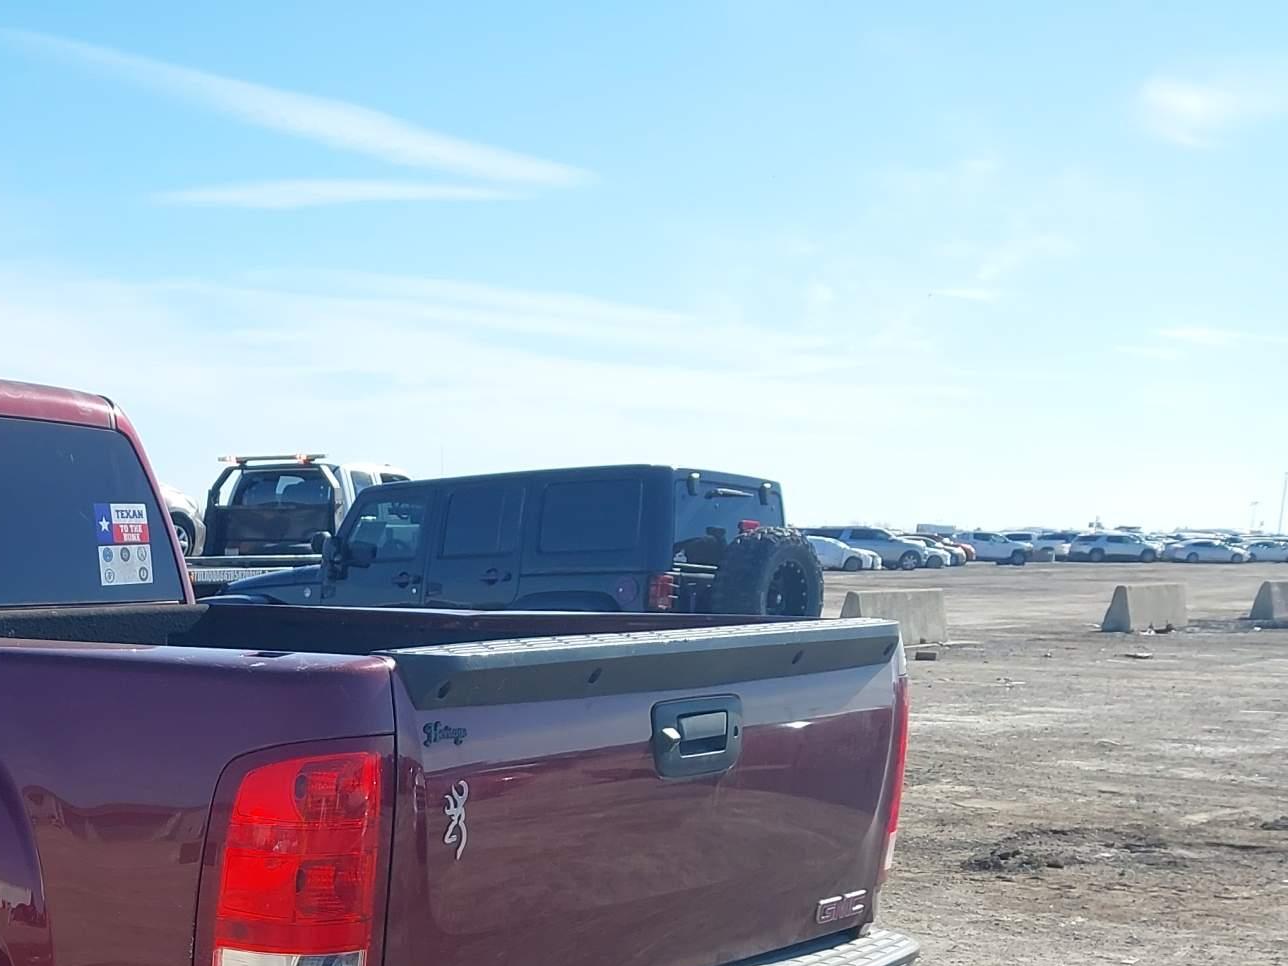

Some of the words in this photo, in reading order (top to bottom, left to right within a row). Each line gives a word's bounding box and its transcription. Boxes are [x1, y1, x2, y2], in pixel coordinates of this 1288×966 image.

[114, 509, 144, 519] TEXAN
[119, 524, 129, 533] TO
[129, 524, 143, 533] THE
[816, 889, 867, 924] GMC
